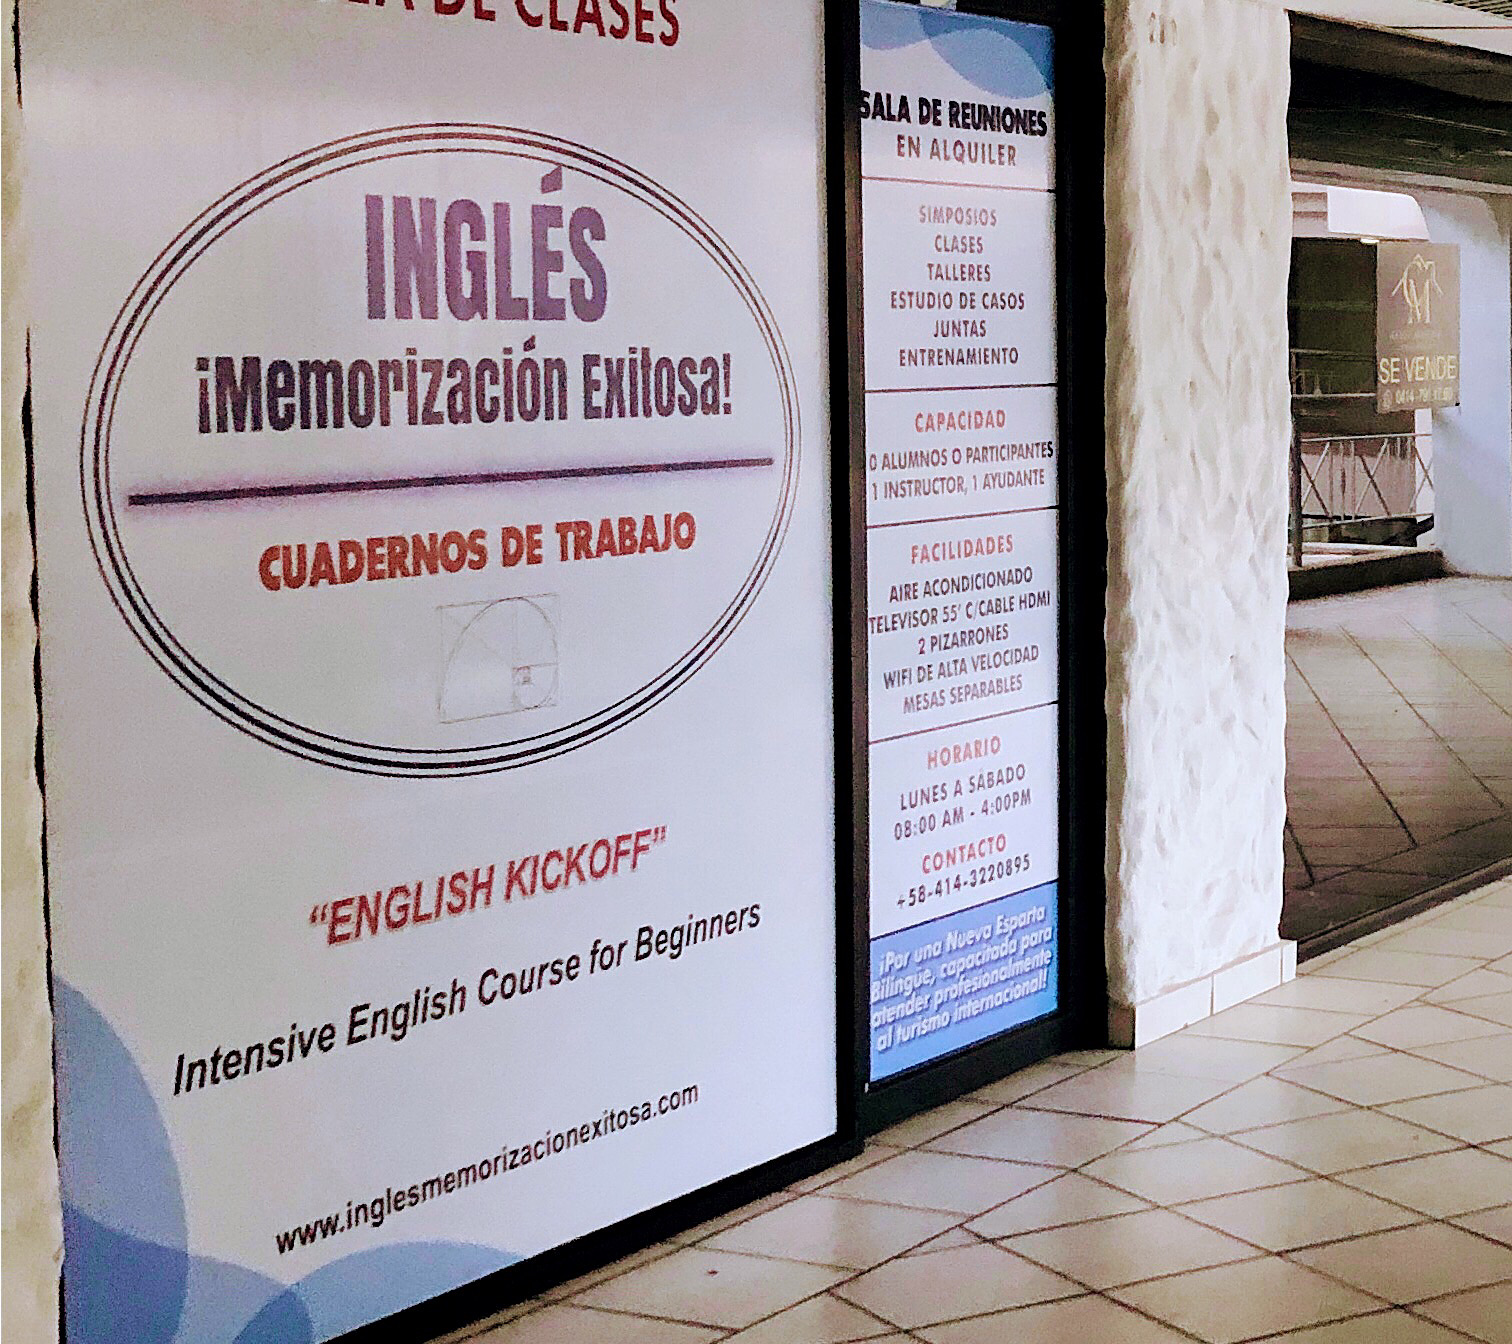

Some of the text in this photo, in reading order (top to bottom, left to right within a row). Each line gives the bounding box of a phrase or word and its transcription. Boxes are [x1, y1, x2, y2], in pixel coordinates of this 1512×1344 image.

[860, 90, 1047, 137] SALA DE REUNIONES
[896, 134, 1017, 167] EN ALQUILER
[919, 205, 997, 227] SIMPOSIOS
[365, 165, 608, 322] INGLÉS
[934, 234, 984, 254] CLASES
[927, 262, 991, 282] TALLERES
[890, 290, 1025, 311] ESTUDIO DE CASOS
[933, 319, 987, 338] JUNTAS
[899, 346, 1019, 368] ENTRENAMIENTO
[1378, 355, 1456, 384] SE VENDE
[196, 335, 733, 434] ¡Memorización Exitosa!
[914, 409, 1006, 433] CAPACIDAD
[881, 448, 948, 471] ALUMNOS
[952, 447, 962, 465] O
[966, 441, 1054, 464] PARTICIPANTES
[872, 468, 1045, 501] 1 INSTRUCTOR, 1 AYUDANTE
[258, 511, 697, 591] CUADERNOS DE TRABAJO
[911, 534, 1014, 565] FACILIDADES
[889, 565, 1033, 604] AIRE ACONDICIONADO
[869, 607, 938, 635] TELEVISOR
[965, 595, 1015, 621] C/CABLE
[1019, 589, 1051, 610] HDMI
[918, 623, 1010, 655] 2 PIZARRONES
[883, 644, 1040, 690] WIFI DE ALTA VELOCIDAD
[903, 673, 1023, 714] MESAS SEPARABLES
[927, 735, 1002, 771] HORARIO
[894, 813, 936, 841] 08:00
[942, 806, 965, 828] AM
[981, 788, 1032, 816] 4:00PM
[900, 782, 948, 811] LUNES
[953, 779, 963, 797] A
[922, 833, 1006, 875] CONTACTO
[897, 853, 1030, 909] +58-414-3220895
[914, 940, 943, 963] una
[946, 923, 993, 953] Nueva
[996, 905, 1046, 936] Esparta
[940, 937, 1018, 978] capacitada
[1020, 926, 1053, 955] para
[172, 901, 762, 1095] Intensive English Course for Beginners
[871, 950, 1052, 1028] atender profesionalmente
[877, 968, 1048, 1052] al turismo internacional!
[275, 1081, 700, 1255] www.inglesmemorizacionexitosa.com
